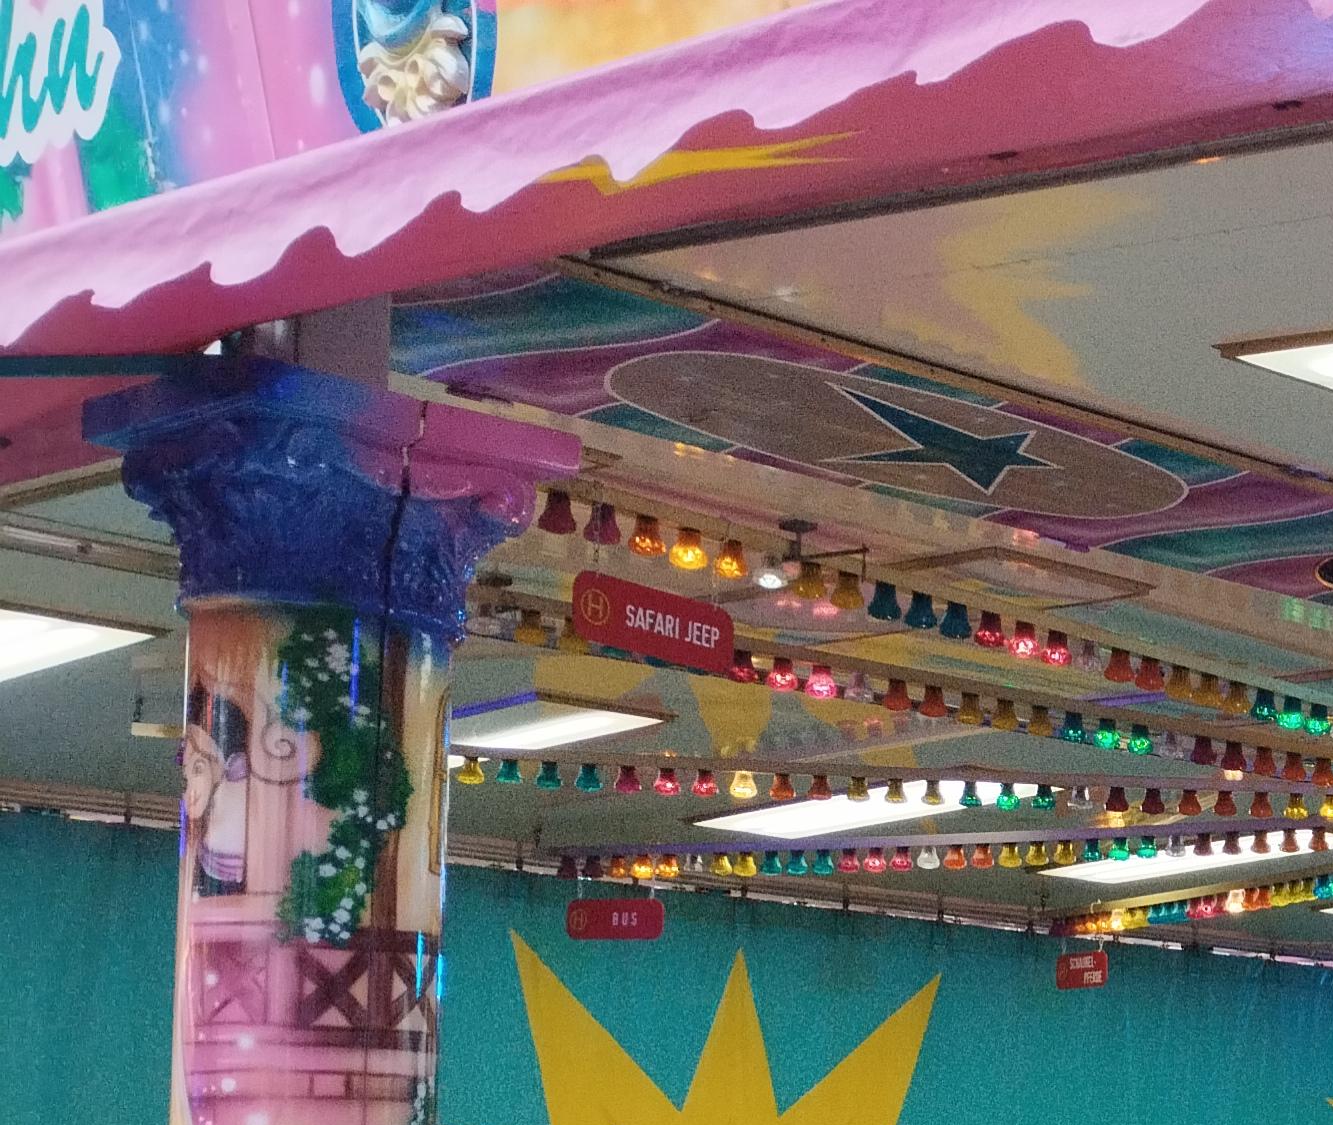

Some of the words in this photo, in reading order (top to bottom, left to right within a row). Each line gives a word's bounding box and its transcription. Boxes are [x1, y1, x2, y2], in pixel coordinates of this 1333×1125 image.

[625, 604, 680, 640] SAFARI
[684, 620, 720, 649] JEEP
[612, 911, 638, 927] BUS
